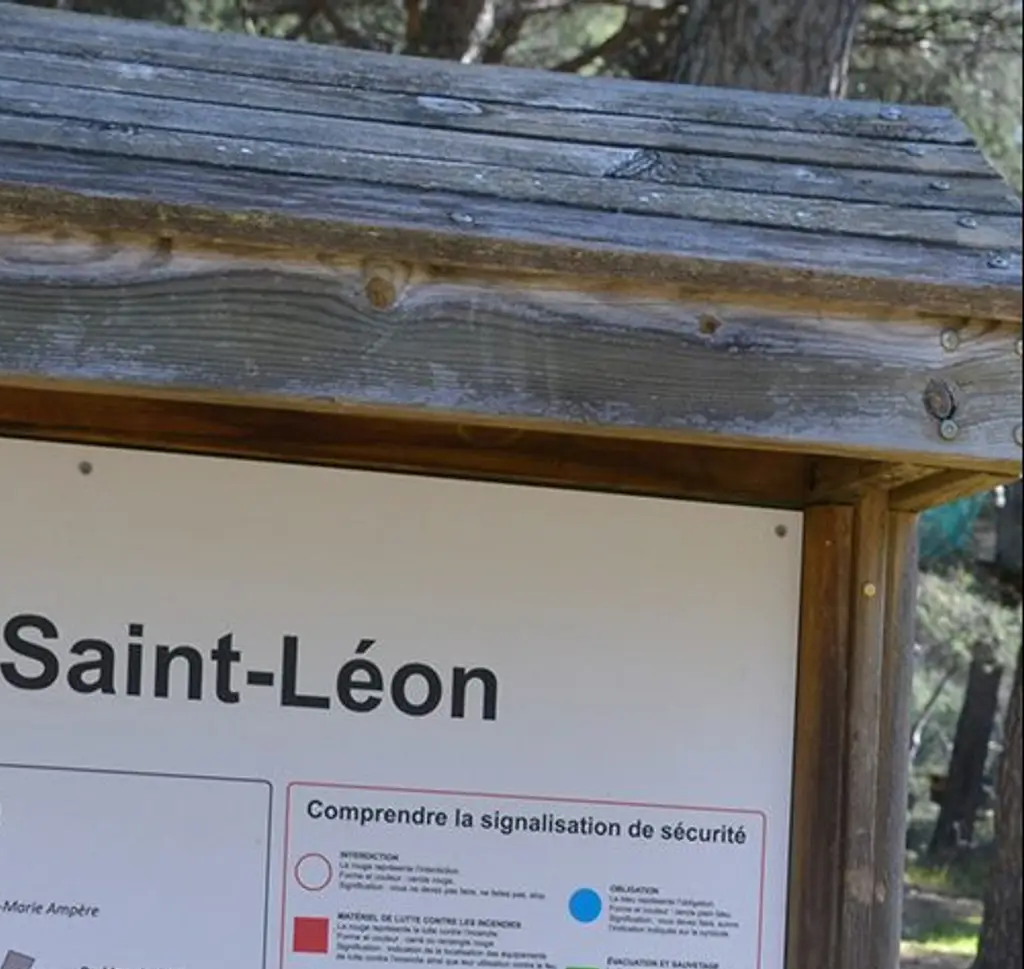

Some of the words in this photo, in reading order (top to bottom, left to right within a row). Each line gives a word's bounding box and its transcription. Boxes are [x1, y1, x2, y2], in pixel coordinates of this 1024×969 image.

[0, 614, 497, 721] Saint-Léon
[307, 799, 448, 826] Comprendre
[455, 808, 473, 828] la
[480, 810, 621, 836] signalisation
[628, 819, 654, 839] de
[661, 822, 746, 844] sécurité
